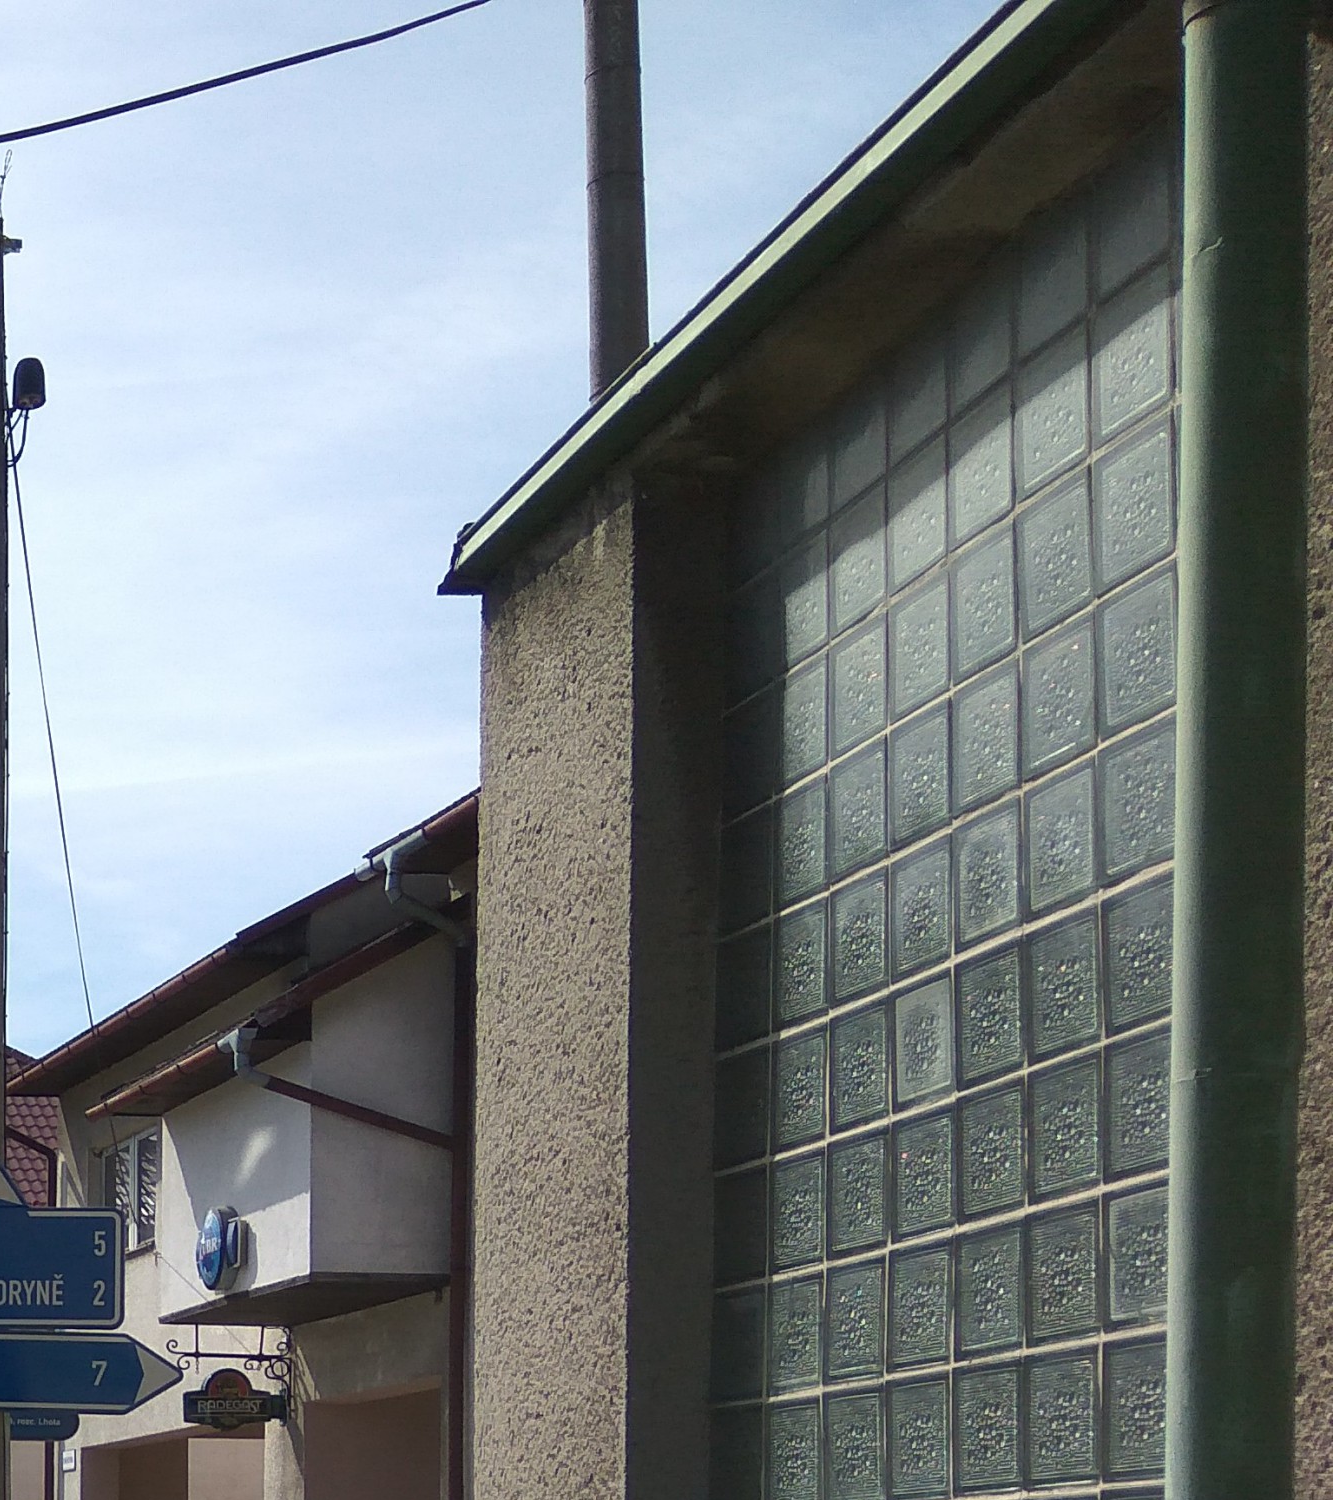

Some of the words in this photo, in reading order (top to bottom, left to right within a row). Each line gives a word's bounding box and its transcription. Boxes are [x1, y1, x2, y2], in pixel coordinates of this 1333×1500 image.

[93, 1231, 107, 1257] 5
[92, 1280, 106, 1307] 2
[91, 1360, 108, 1387] 7
[197, 1400, 263, 1414] RADEGAST
[38, 1417, 61, 1426] Lhota
